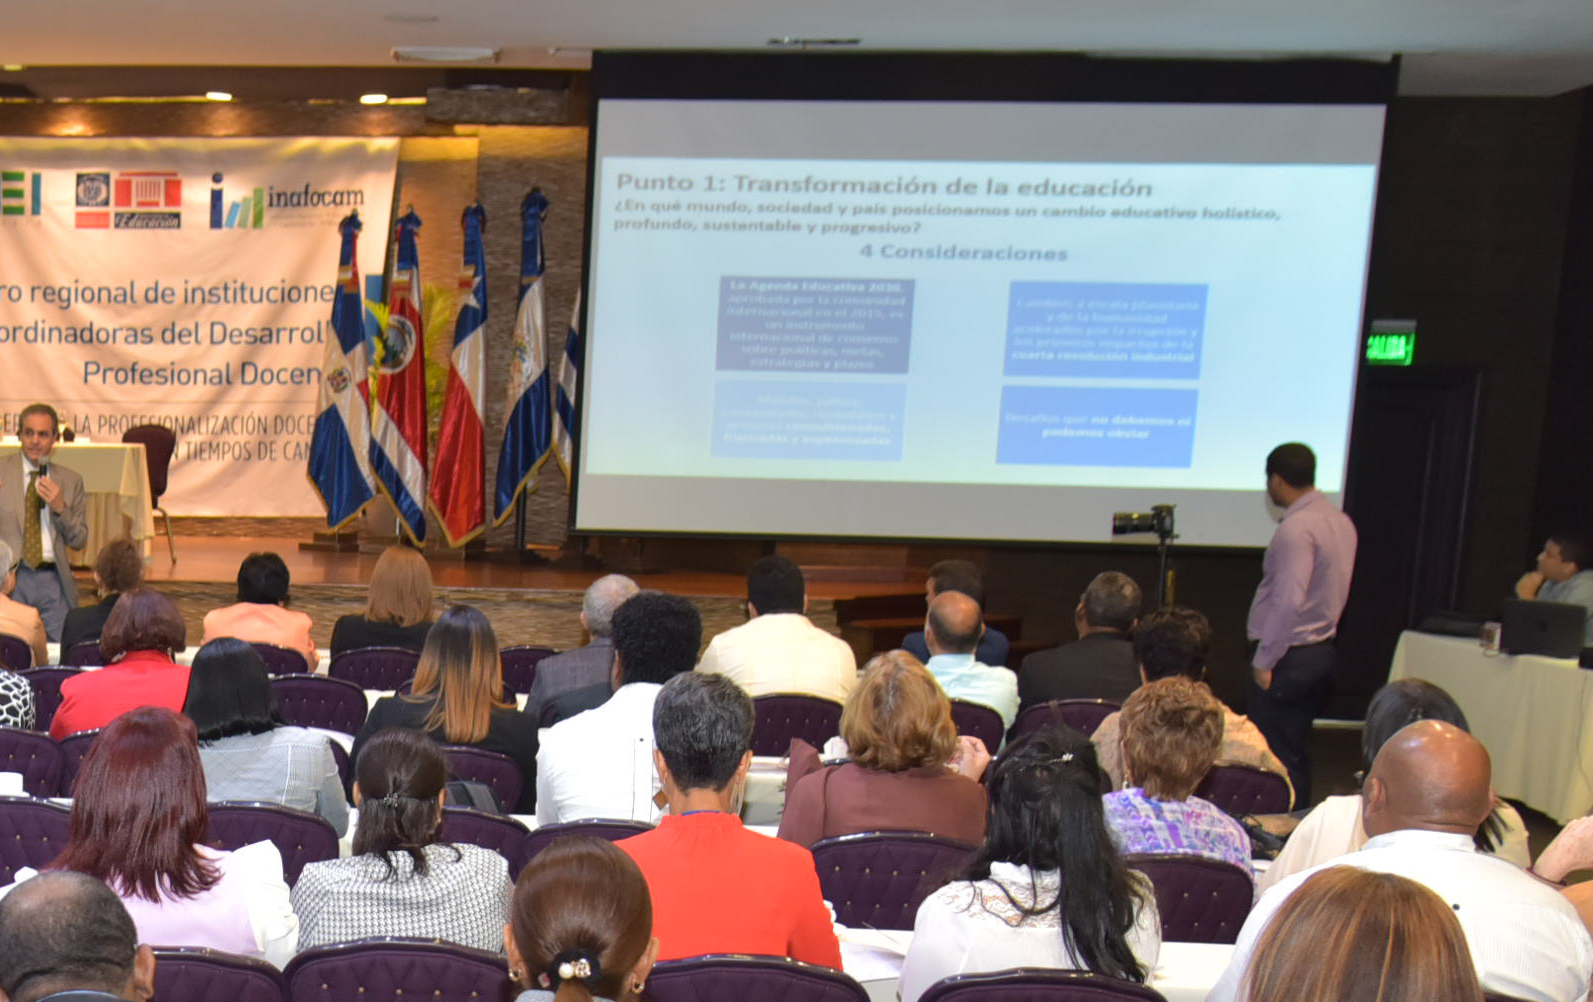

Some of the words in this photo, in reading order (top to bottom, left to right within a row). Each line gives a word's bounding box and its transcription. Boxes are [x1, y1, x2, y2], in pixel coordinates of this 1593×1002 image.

[268, 183, 364, 208] inafocam
[617, 174, 694, 192] Punto
[703, 175, 725, 192] 1:
[733, 175, 937, 195] Transformación
[945, 178, 978, 195] de
[985, 178, 1008, 196] la
[1017, 178, 1153, 198] educación
[687, 200, 752, 215] mundo,
[757, 201, 833, 214] sociedad
[838, 205, 847, 216] y
[892, 203, 1010, 218] posicionamos
[1015, 206, 1037, 217] un
[1042, 205, 1105, 218] cambio
[1110, 205, 1196, 219] educativo
[614, 217, 698, 232] profundo,
[703, 219, 802, 232] sustentable
[807, 223, 816, 234] y
[821, 222, 921, 235] progresivo?
[859, 244, 874, 260] 4
[880, 244, 1069, 262] Consideraciones
[30, 279, 137, 310] regional
[144, 279, 176, 304] de
[184, 279, 335, 304] institucione
[749, 281, 799, 292] Agenda
[802, 281, 865, 291] Educativa
[161, 320, 202, 345] del
[84, 360, 233, 386] Profesional
[240, 361, 322, 386] Docen
[74, 414, 92, 434] LA
[274, 414, 314, 435] DOCE
[186, 441, 252, 462] TIEMPOS
[258, 441, 278, 462] DE
